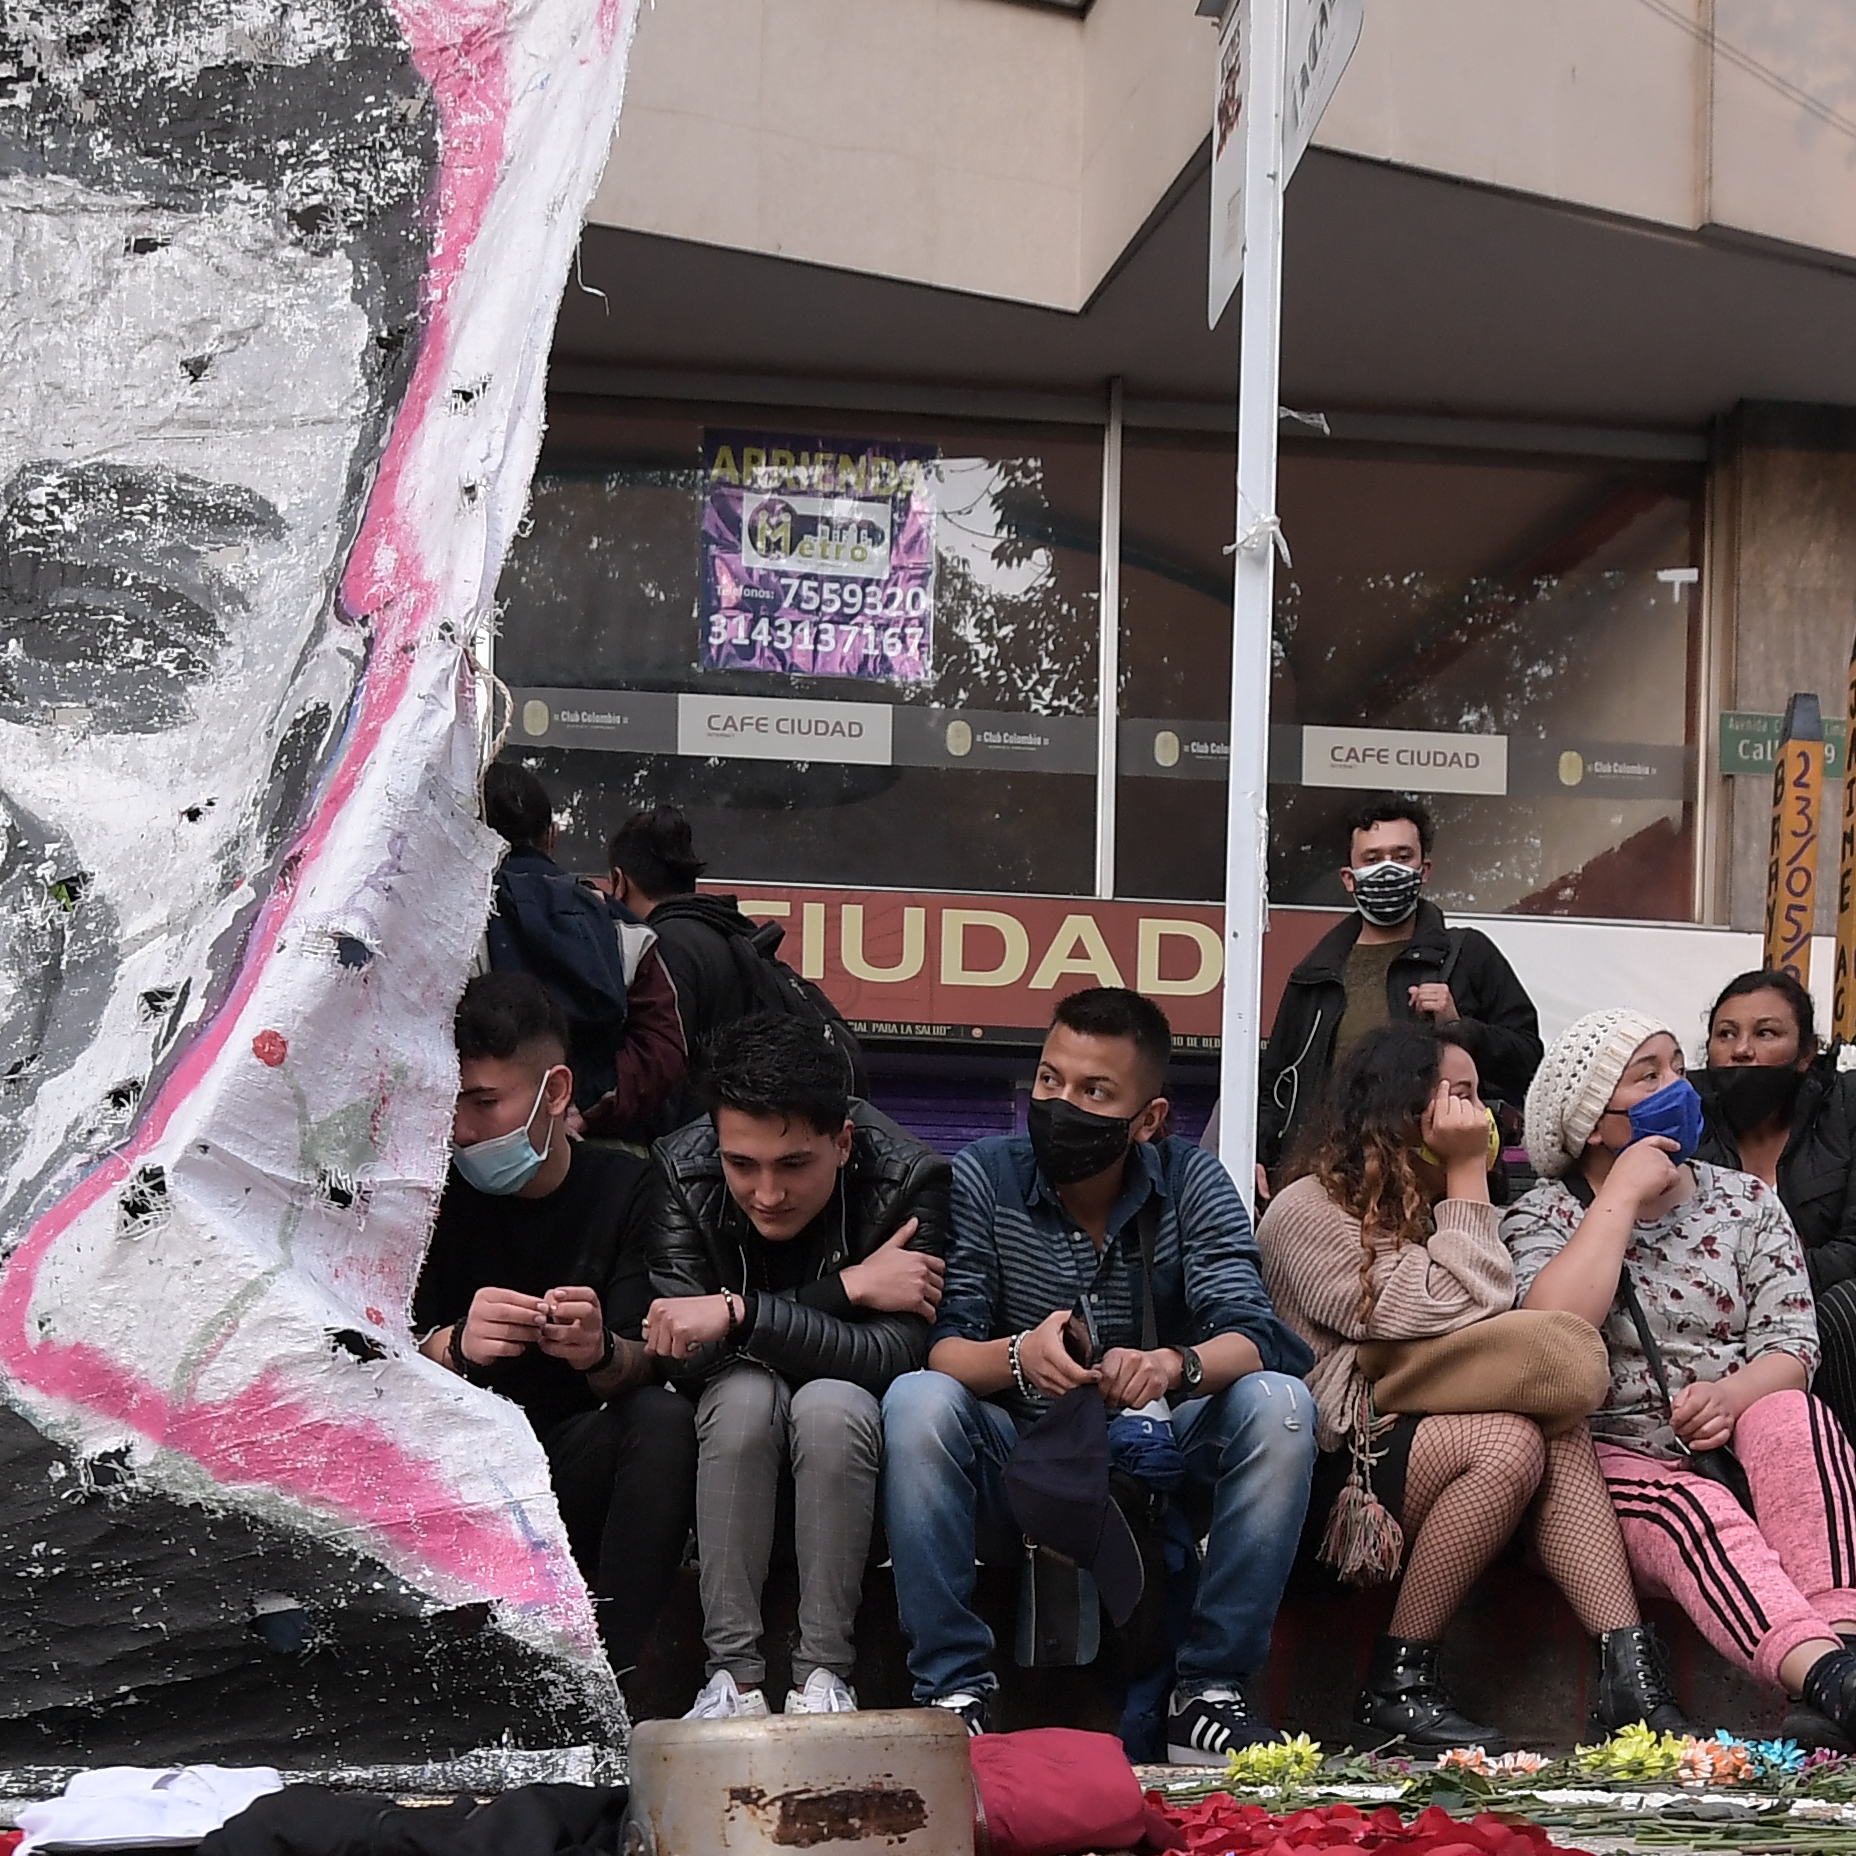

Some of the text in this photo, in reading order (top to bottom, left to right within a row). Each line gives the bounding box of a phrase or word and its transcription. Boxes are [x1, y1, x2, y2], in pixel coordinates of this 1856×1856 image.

[709, 445, 929, 497] ARRIENDA
[779, 577, 928, 618] 7559320
[707, 613, 925, 658] 3143137167
[706, 713, 865, 739] CAFE CIUDAD
[1329, 745, 1480, 770] CAFE CIUDAD
[1824, 742, 1837, 765] 9
[871, 1023, 899, 1035] PARA
[900, 1024, 913, 1035] LA
